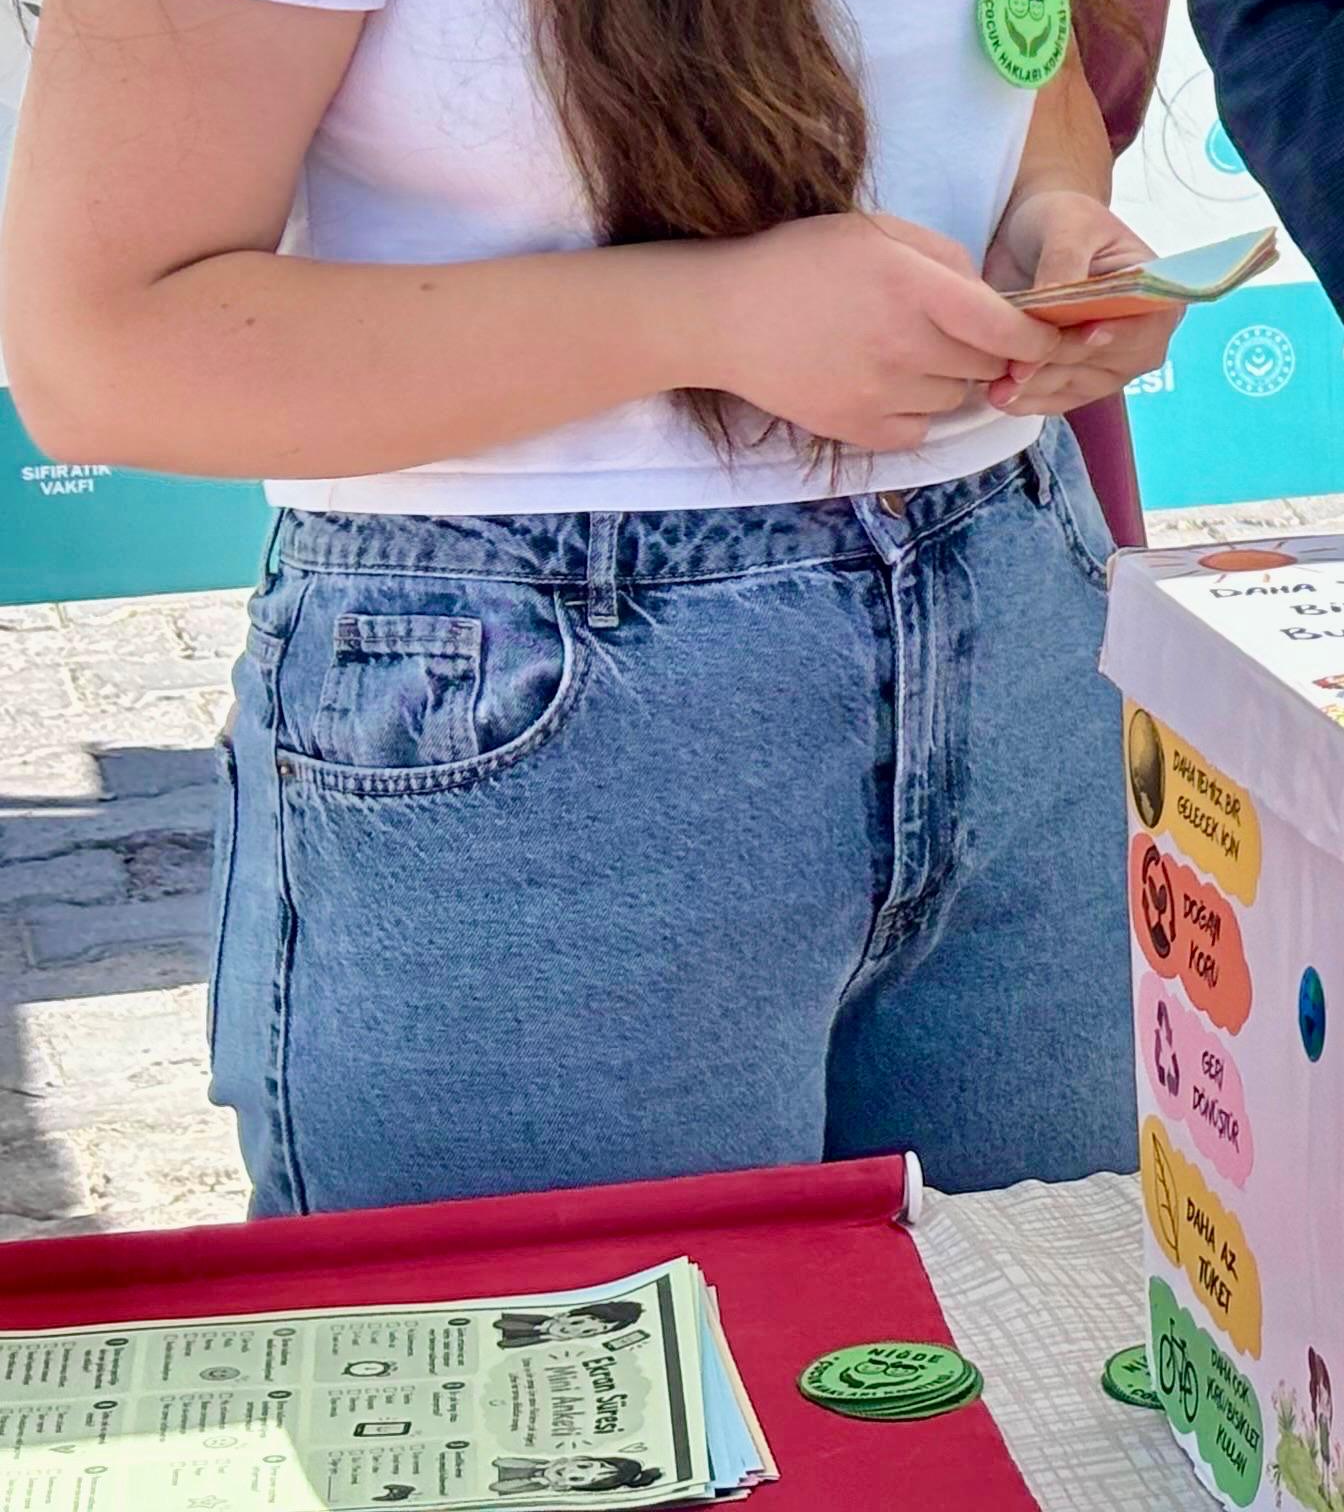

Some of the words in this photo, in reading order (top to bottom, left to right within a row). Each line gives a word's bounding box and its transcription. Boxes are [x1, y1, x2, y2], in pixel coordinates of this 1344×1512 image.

[40, 478, 95, 496] VAKFI
[1210, 583, 1317, 599] DAHA
[1185, 1196, 1216, 1253] DAHA
[1220, 1241, 1239, 1282] AZ
[544, 1365, 581, 1392] Mini
[582, 1355, 617, 1394] Ekran
[550, 1396, 586, 1436] Anketi
[593, 1393, 628, 1434] Süresi
